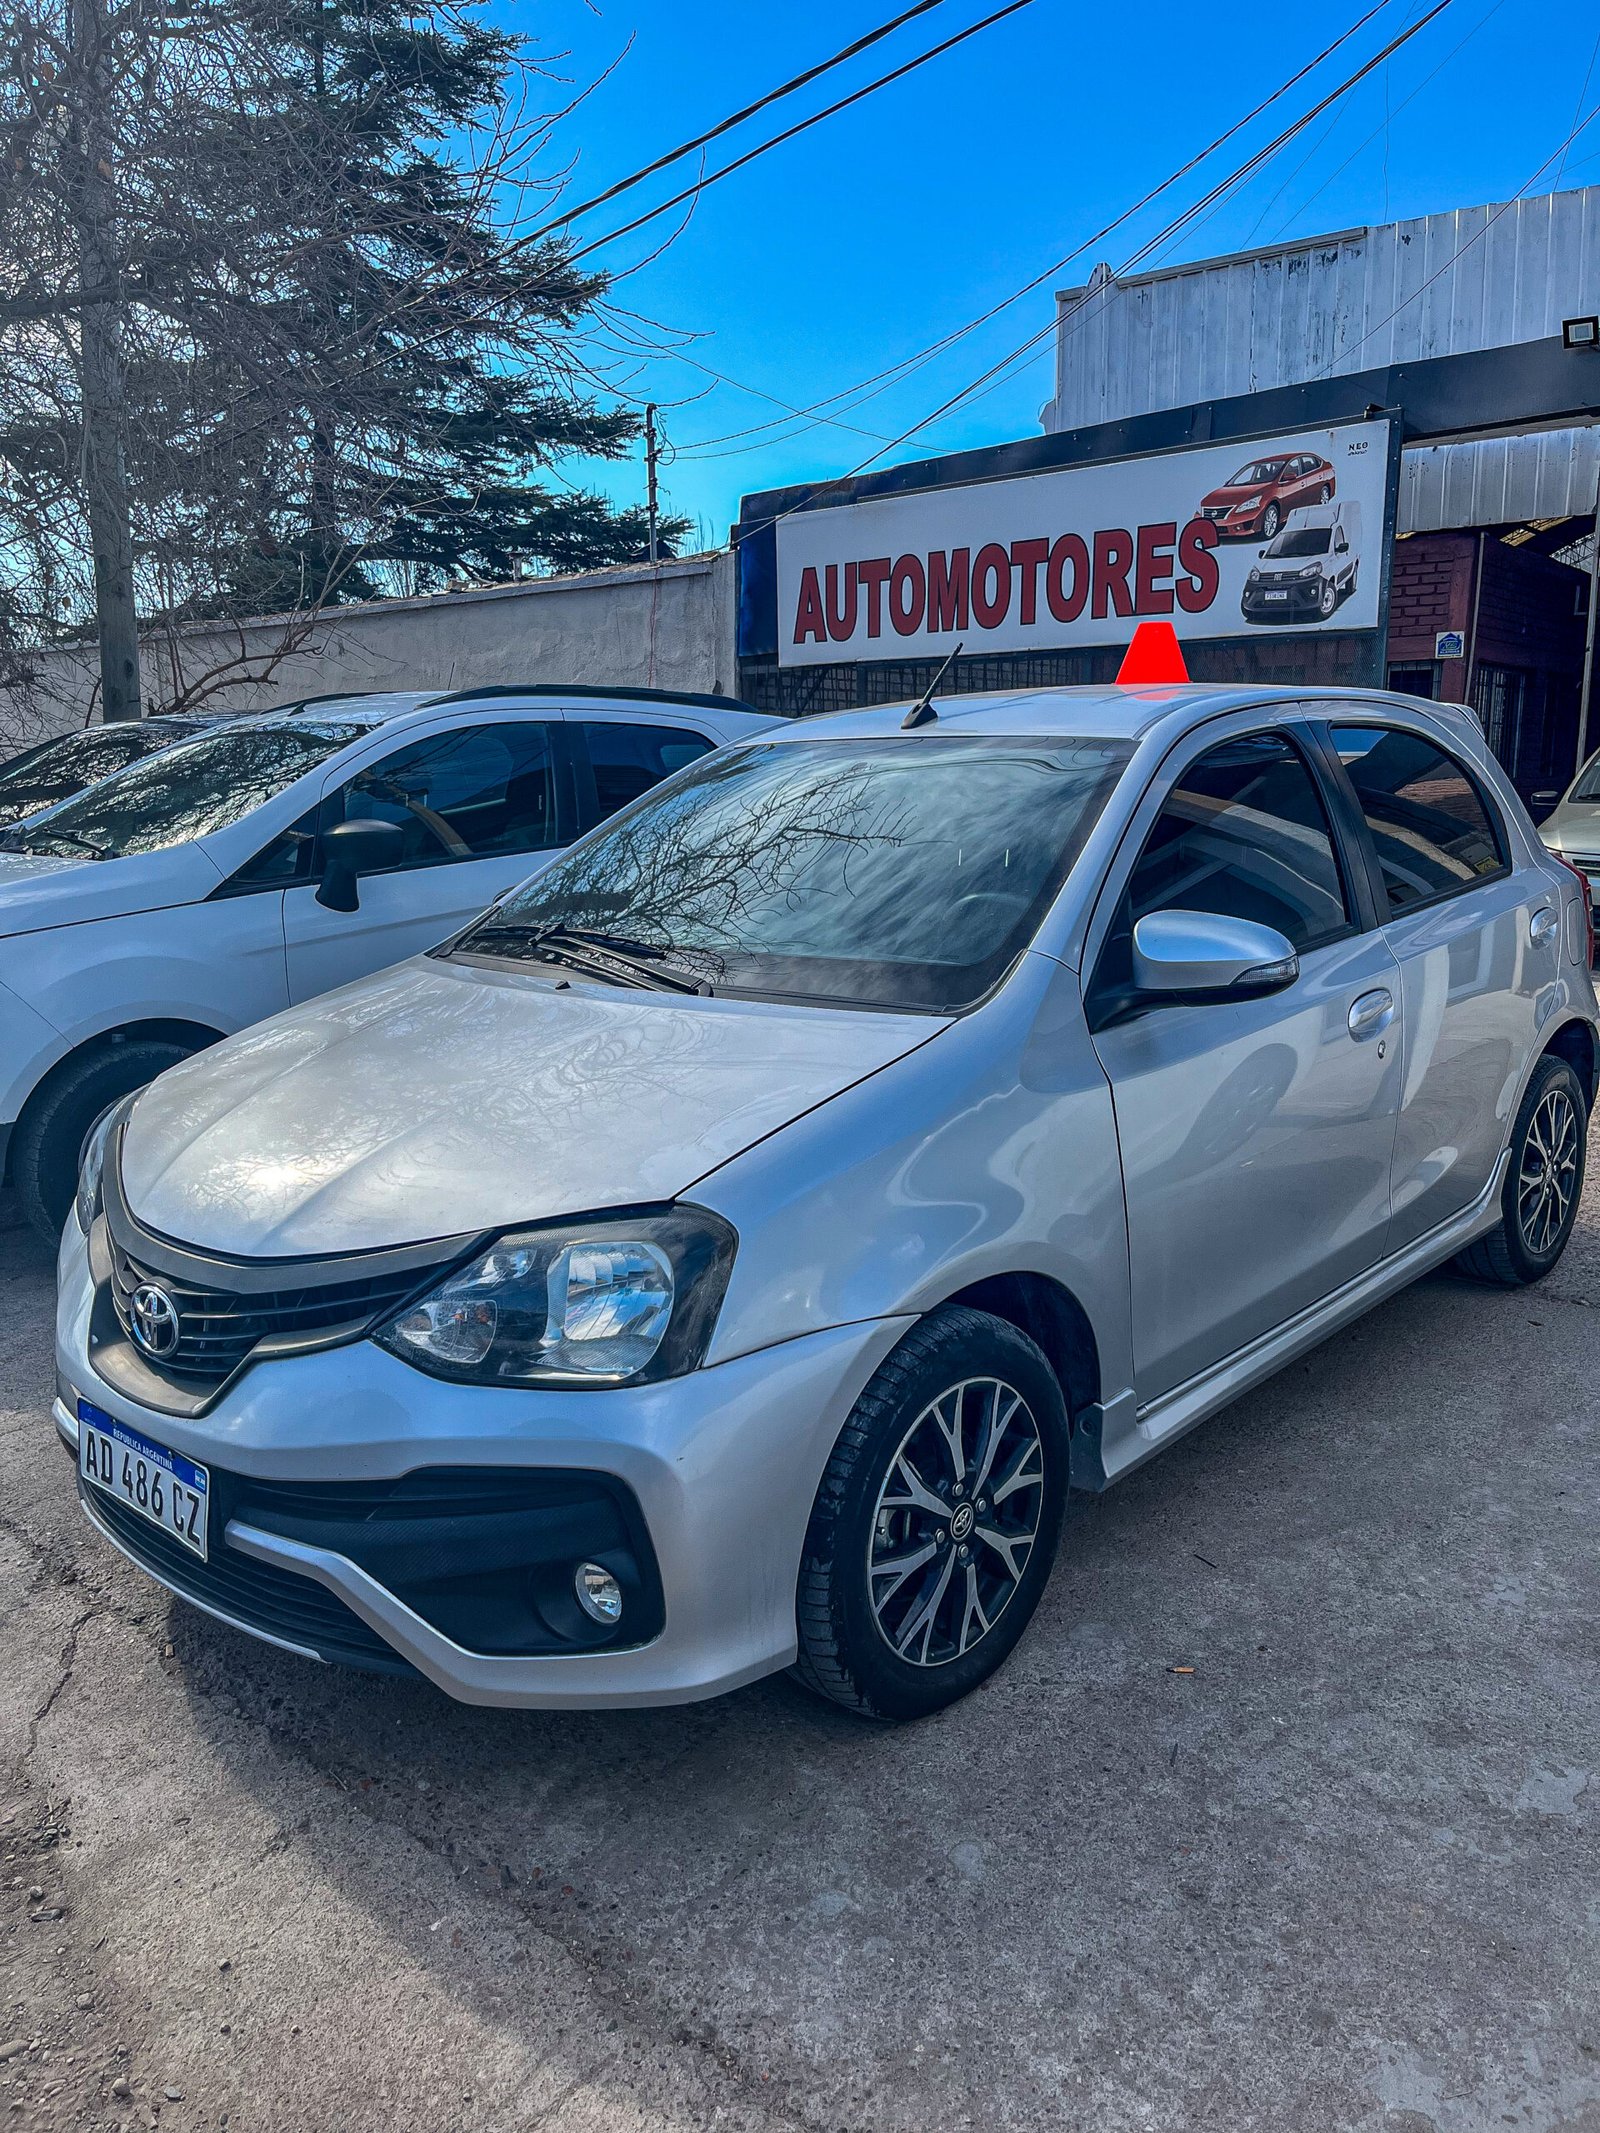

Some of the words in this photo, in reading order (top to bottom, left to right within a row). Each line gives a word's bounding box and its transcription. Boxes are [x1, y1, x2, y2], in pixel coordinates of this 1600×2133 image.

[793, 517, 1221, 644] AUTOMOTORES
[86, 1429, 113, 1485] AD
[121, 1451, 164, 1517] 486
[173, 1481, 200, 1546] CZ
[142, 1443, 173, 1470] ARGENTINA
